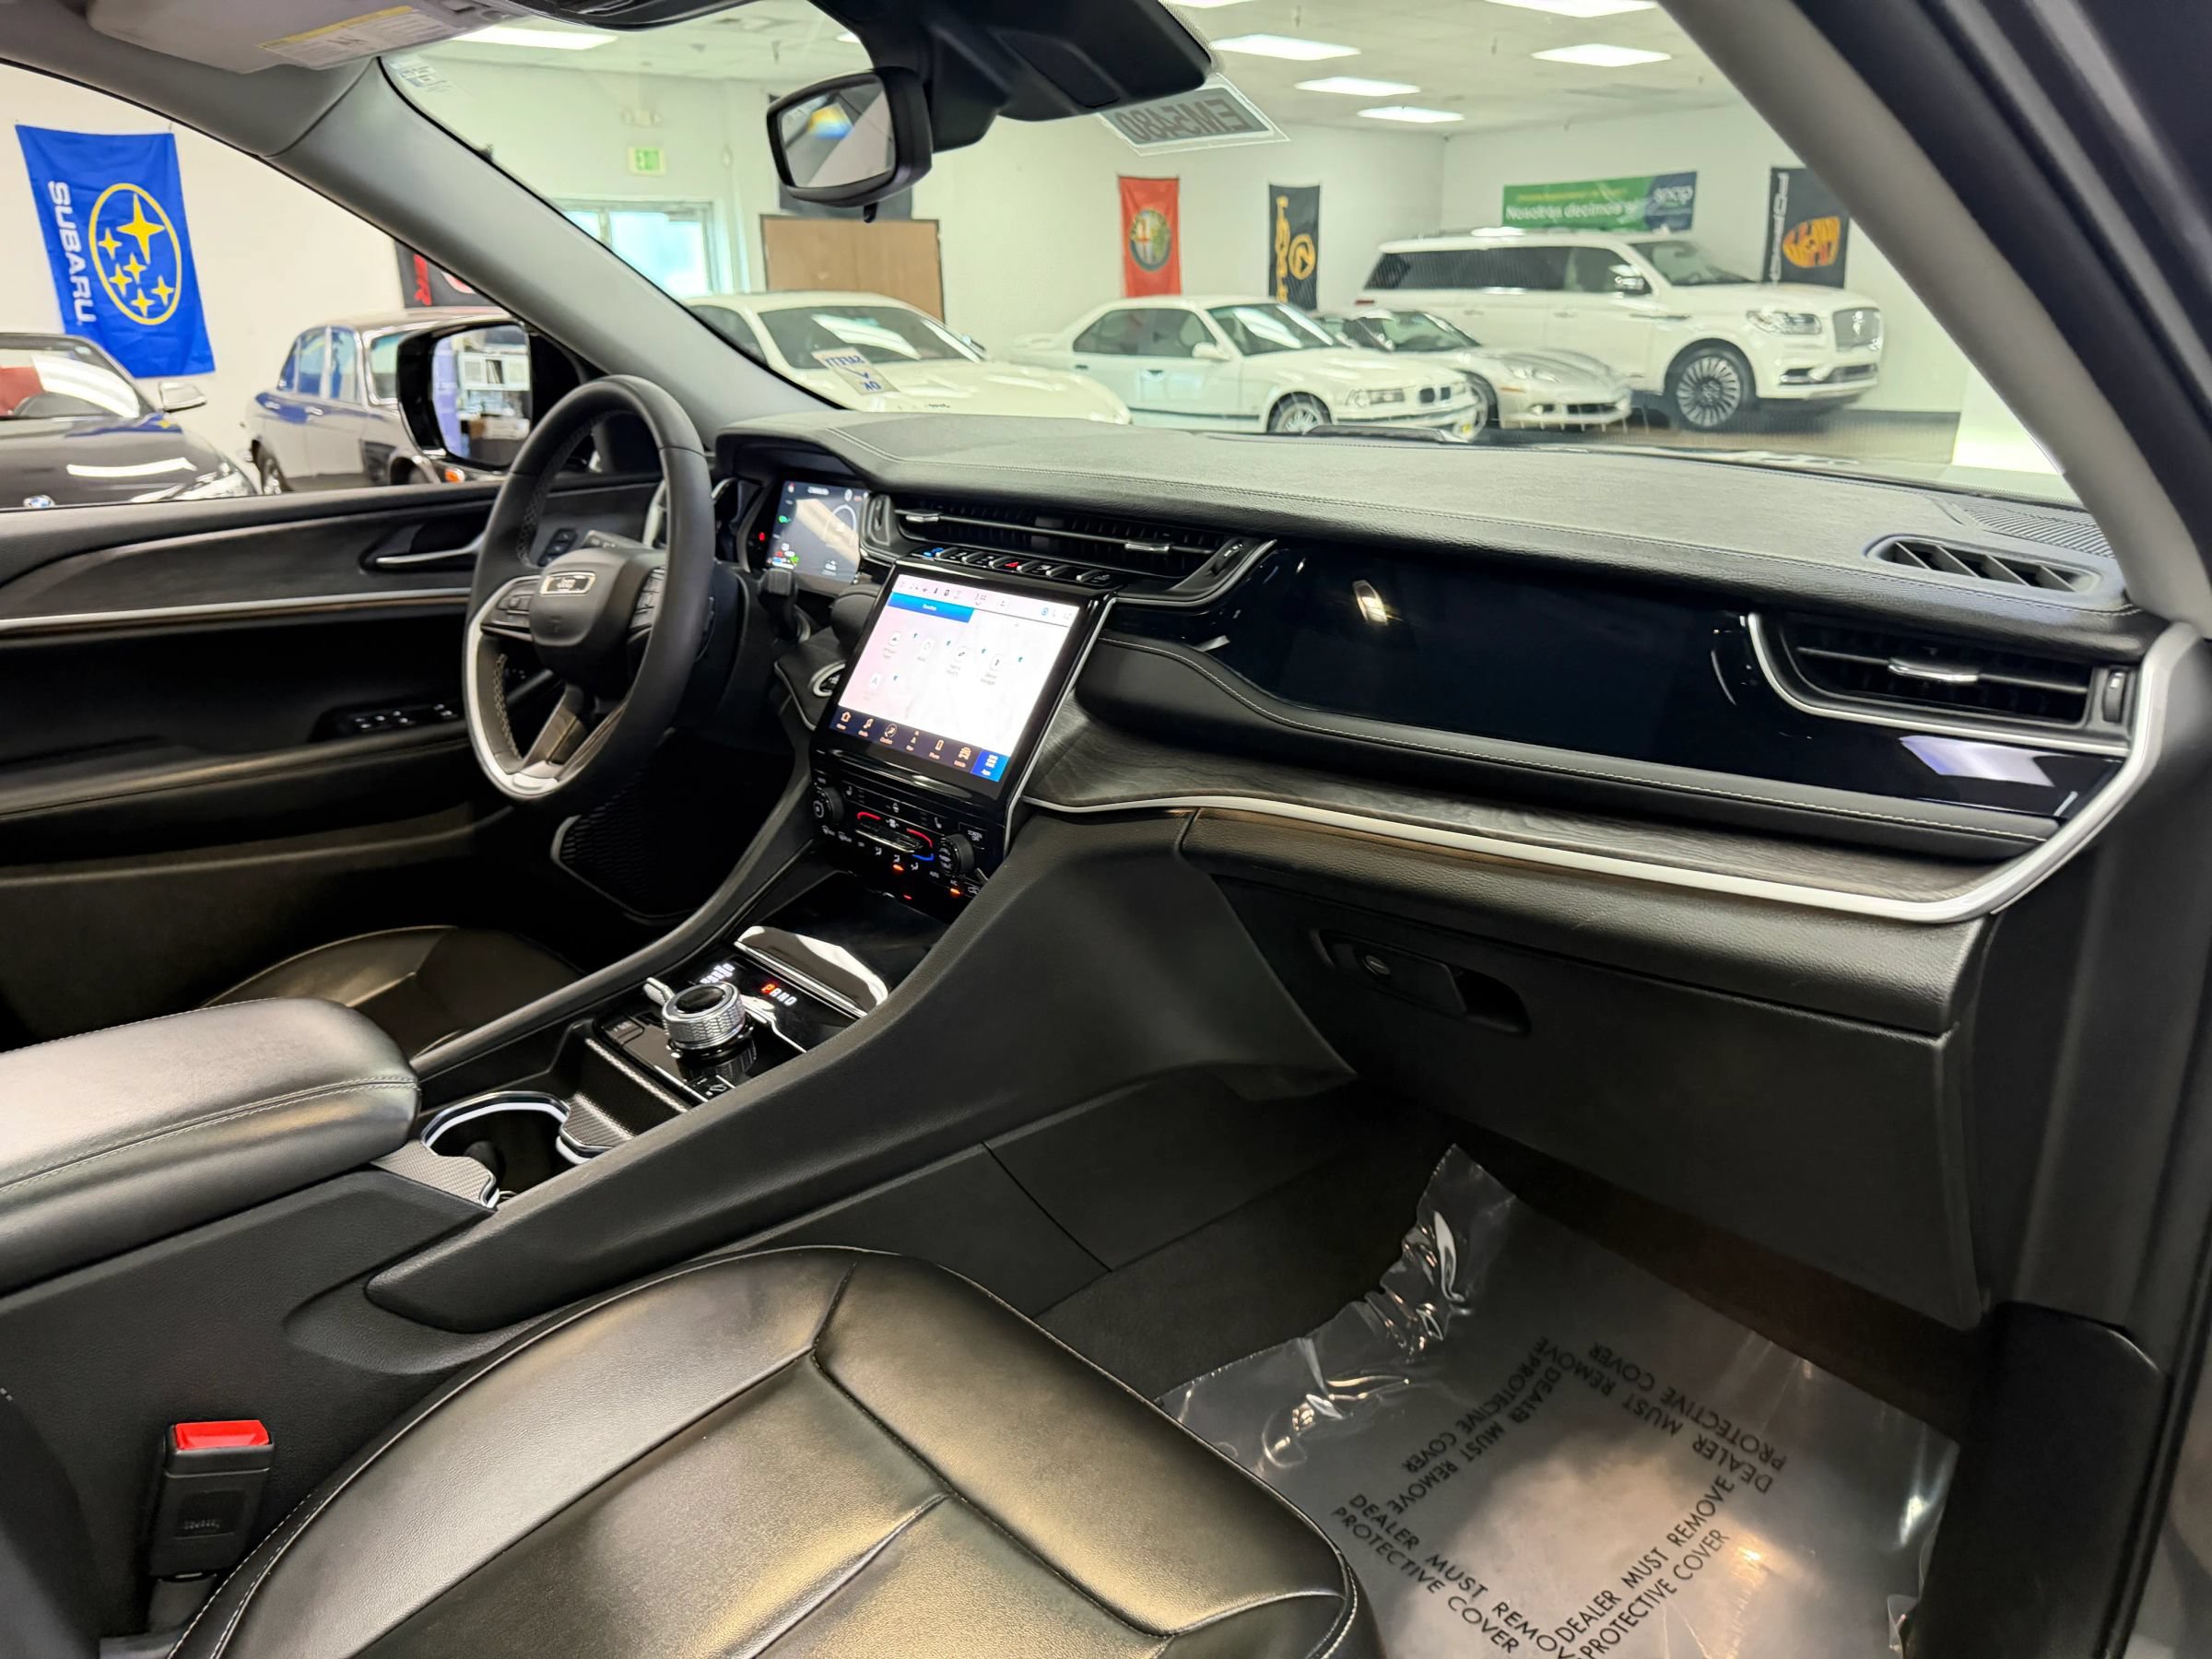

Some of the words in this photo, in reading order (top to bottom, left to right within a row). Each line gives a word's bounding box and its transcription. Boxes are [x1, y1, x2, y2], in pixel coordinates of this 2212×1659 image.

[48, 181, 97, 323] SUBARU
[1455, 1356, 1541, 1435] PROTECTIVE
[1534, 1337, 1617, 1396] REMOVE
[1588, 1342, 1655, 1392] COVER
[1459, 1420, 1506, 1463] MUST
[1622, 1393, 1684, 1438] MUST
[1660, 1386, 1787, 1472] PROTECTIVE
[1387, 1460, 1459, 1514] REMOVE
[1402, 1432, 1457, 1473] COVER
[1692, 1433, 1773, 1495] DEALER
[1331, 1507, 1445, 1594] PROTECTIVE
[1448, 1595, 1520, 1654] COVER
[1349, 1493, 1420, 1551] DEALER
[1426, 1554, 1489, 1598] MUST
[1491, 1601, 1580, 1659] REMOV
[1555, 1590, 1622, 1643] DEALER
[1620, 1547, 1669, 1589] MUST
[1666, 1476, 1735, 1547] REMOVE
[1579, 1578, 1677, 1659] PROTECTIVE
[1673, 1529, 1731, 1581] COVER
